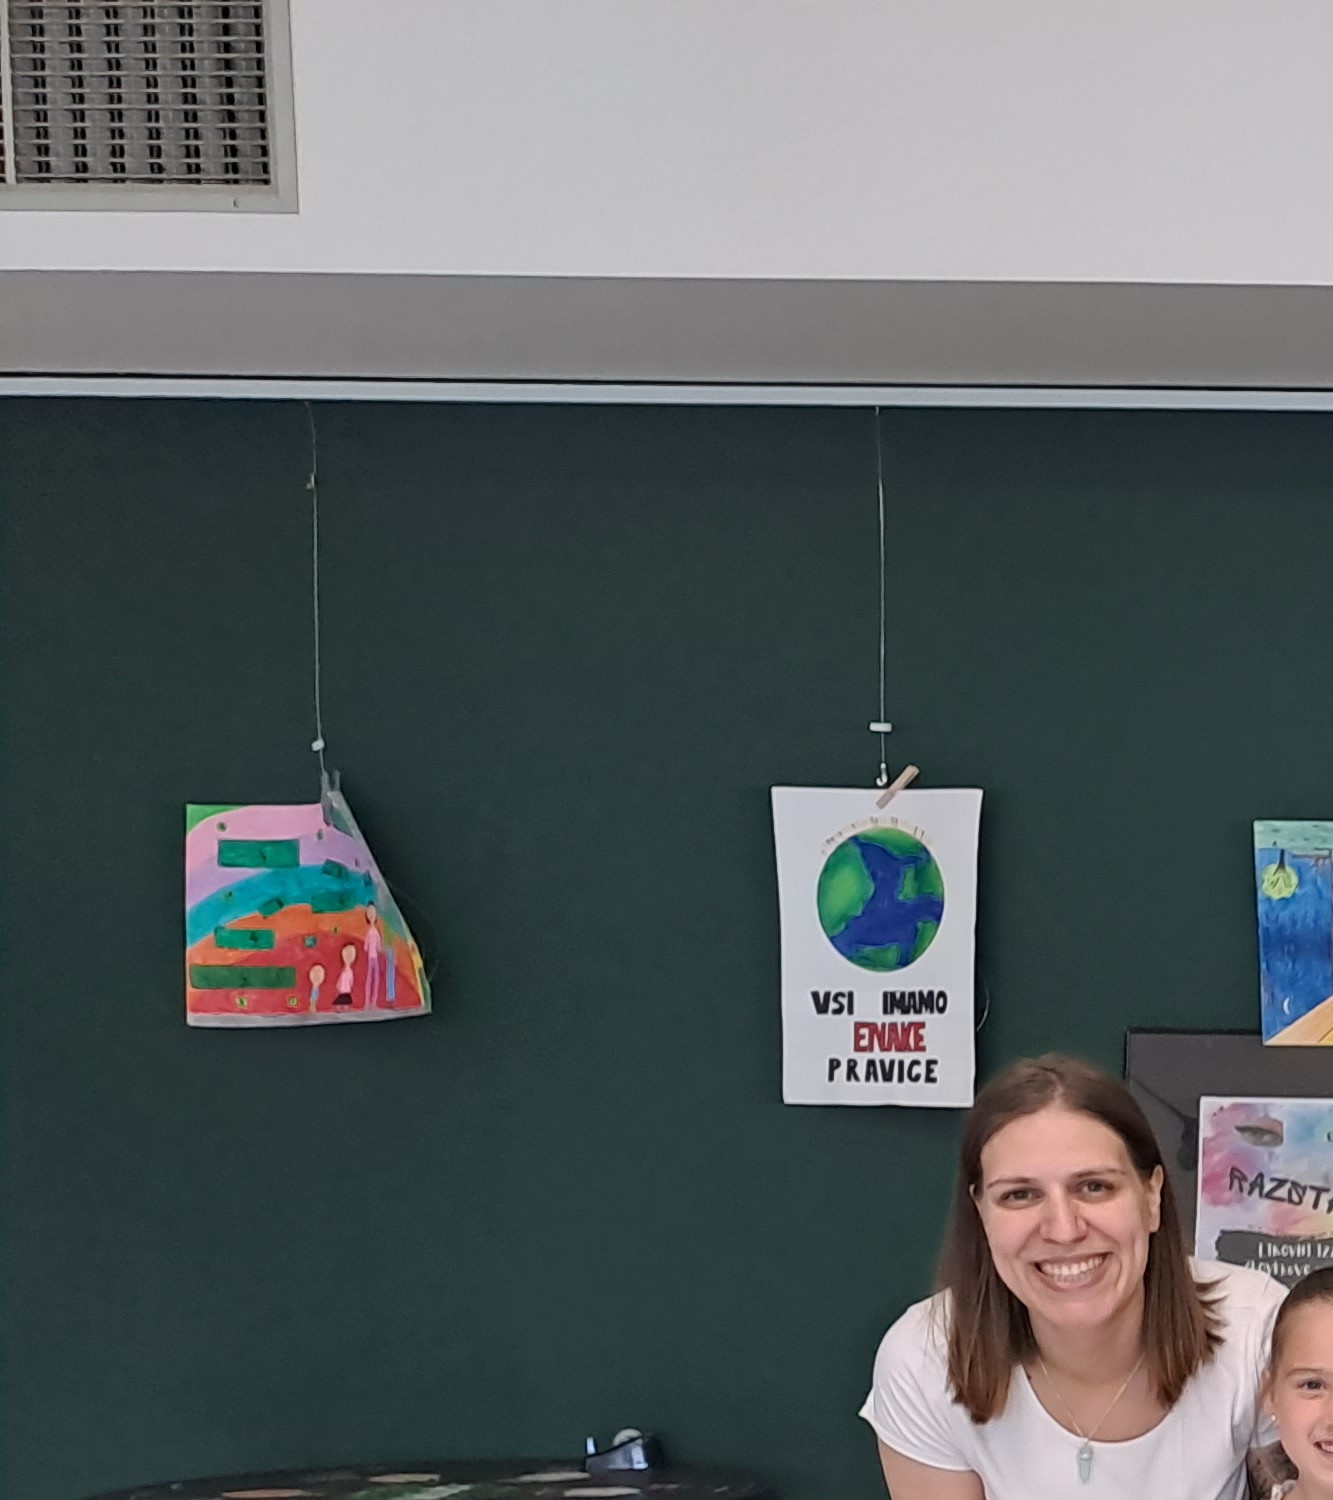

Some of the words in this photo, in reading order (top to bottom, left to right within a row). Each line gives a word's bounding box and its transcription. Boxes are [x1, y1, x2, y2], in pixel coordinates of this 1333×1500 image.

[810, 990, 855, 1016] VSI
[882, 990, 948, 1016] IMAMO
[853, 1021, 927, 1053] ENAKE
[827, 1058, 939, 1084] PRAVICE
